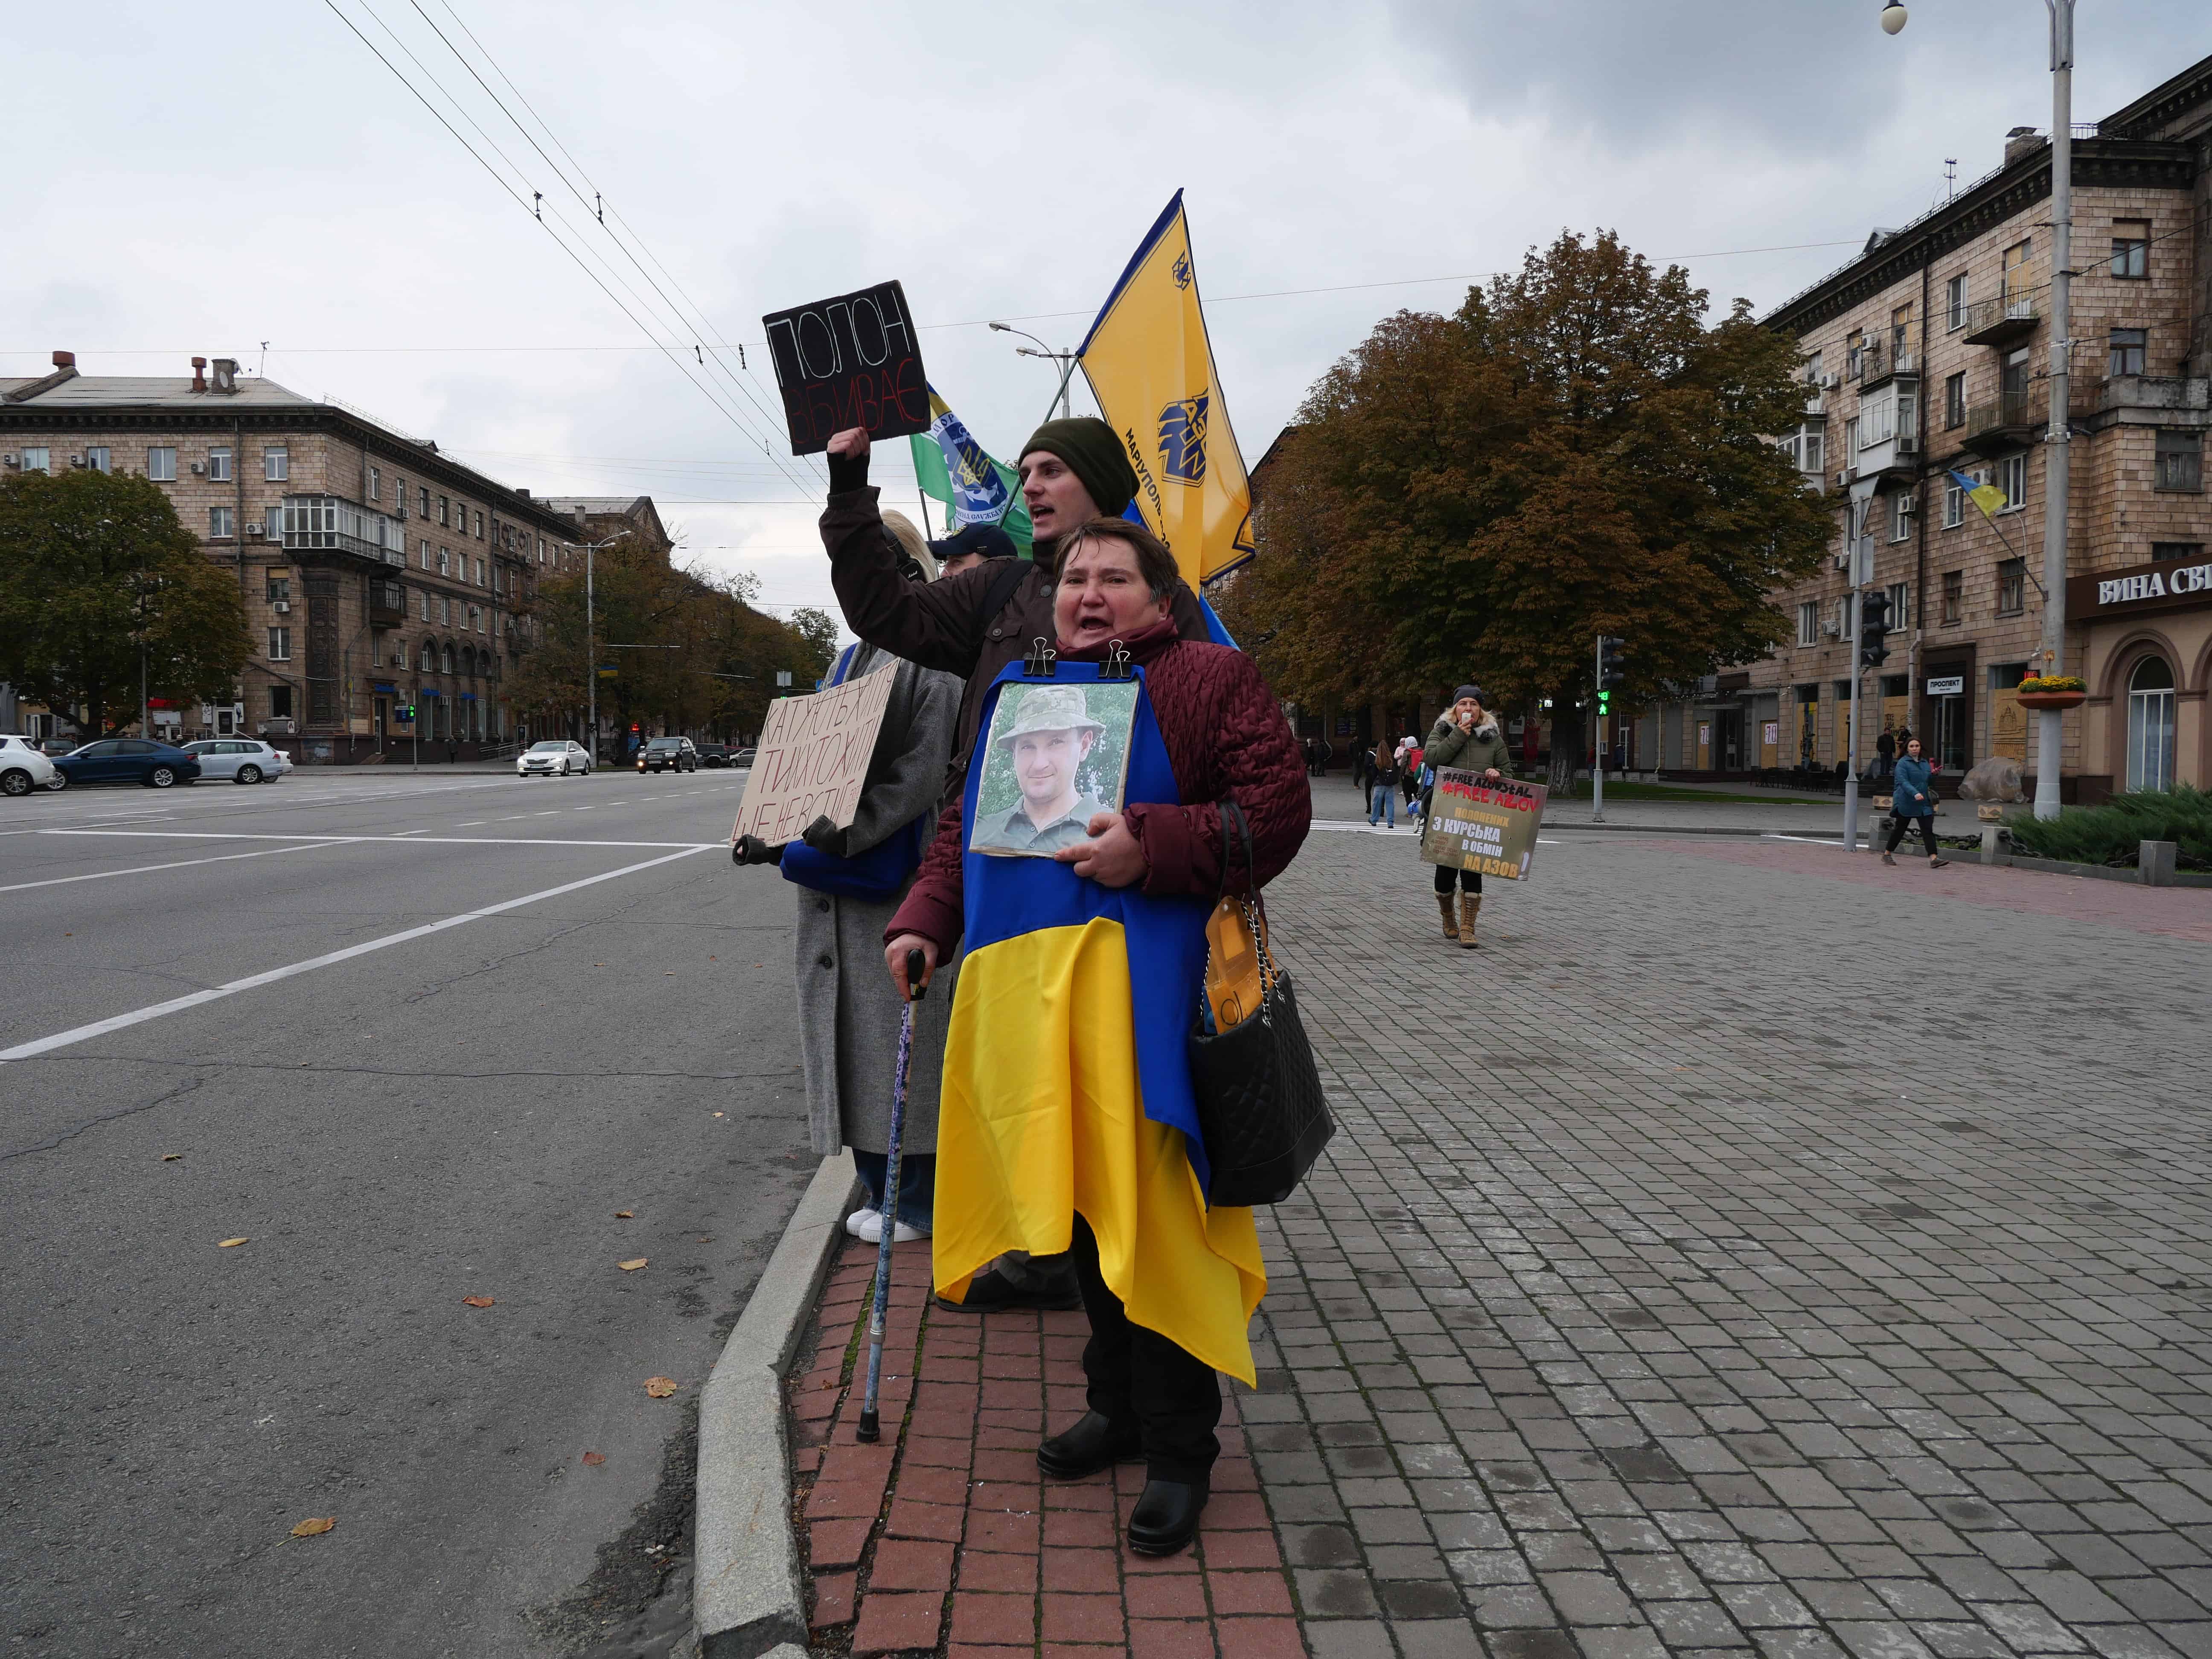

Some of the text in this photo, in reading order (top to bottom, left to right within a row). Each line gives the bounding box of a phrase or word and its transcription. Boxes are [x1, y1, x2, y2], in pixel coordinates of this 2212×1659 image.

[766, 290, 910, 388] ПОЛОН
[783, 358, 924, 444] ВБИВАЄ
[2098, 573, 2167, 605] ВИНА
[1598, 692, 1608, 700] 48
[1930, 679, 1960, 688] ПРОСПЕКТ
[760, 684, 848, 746] КАТУЮТЬ
[760, 743, 808, 793] ТИХ
[795, 732, 841, 789] ХТО
[1443, 772, 1474, 786] #FREE
[1442, 782, 1540, 813] #FREE AZOV
[772, 796, 801, 842] НЕ
[1444, 819, 1501, 842] КУРСЬКА
[1454, 807, 1509, 827] ПОЛОНЕНИХ
[1462, 839, 1469, 850] В
[1470, 841, 1503, 857] ОБМІН
[1464, 854, 1481, 871] НА
[1481, 858, 1518, 878] АЗОВ
